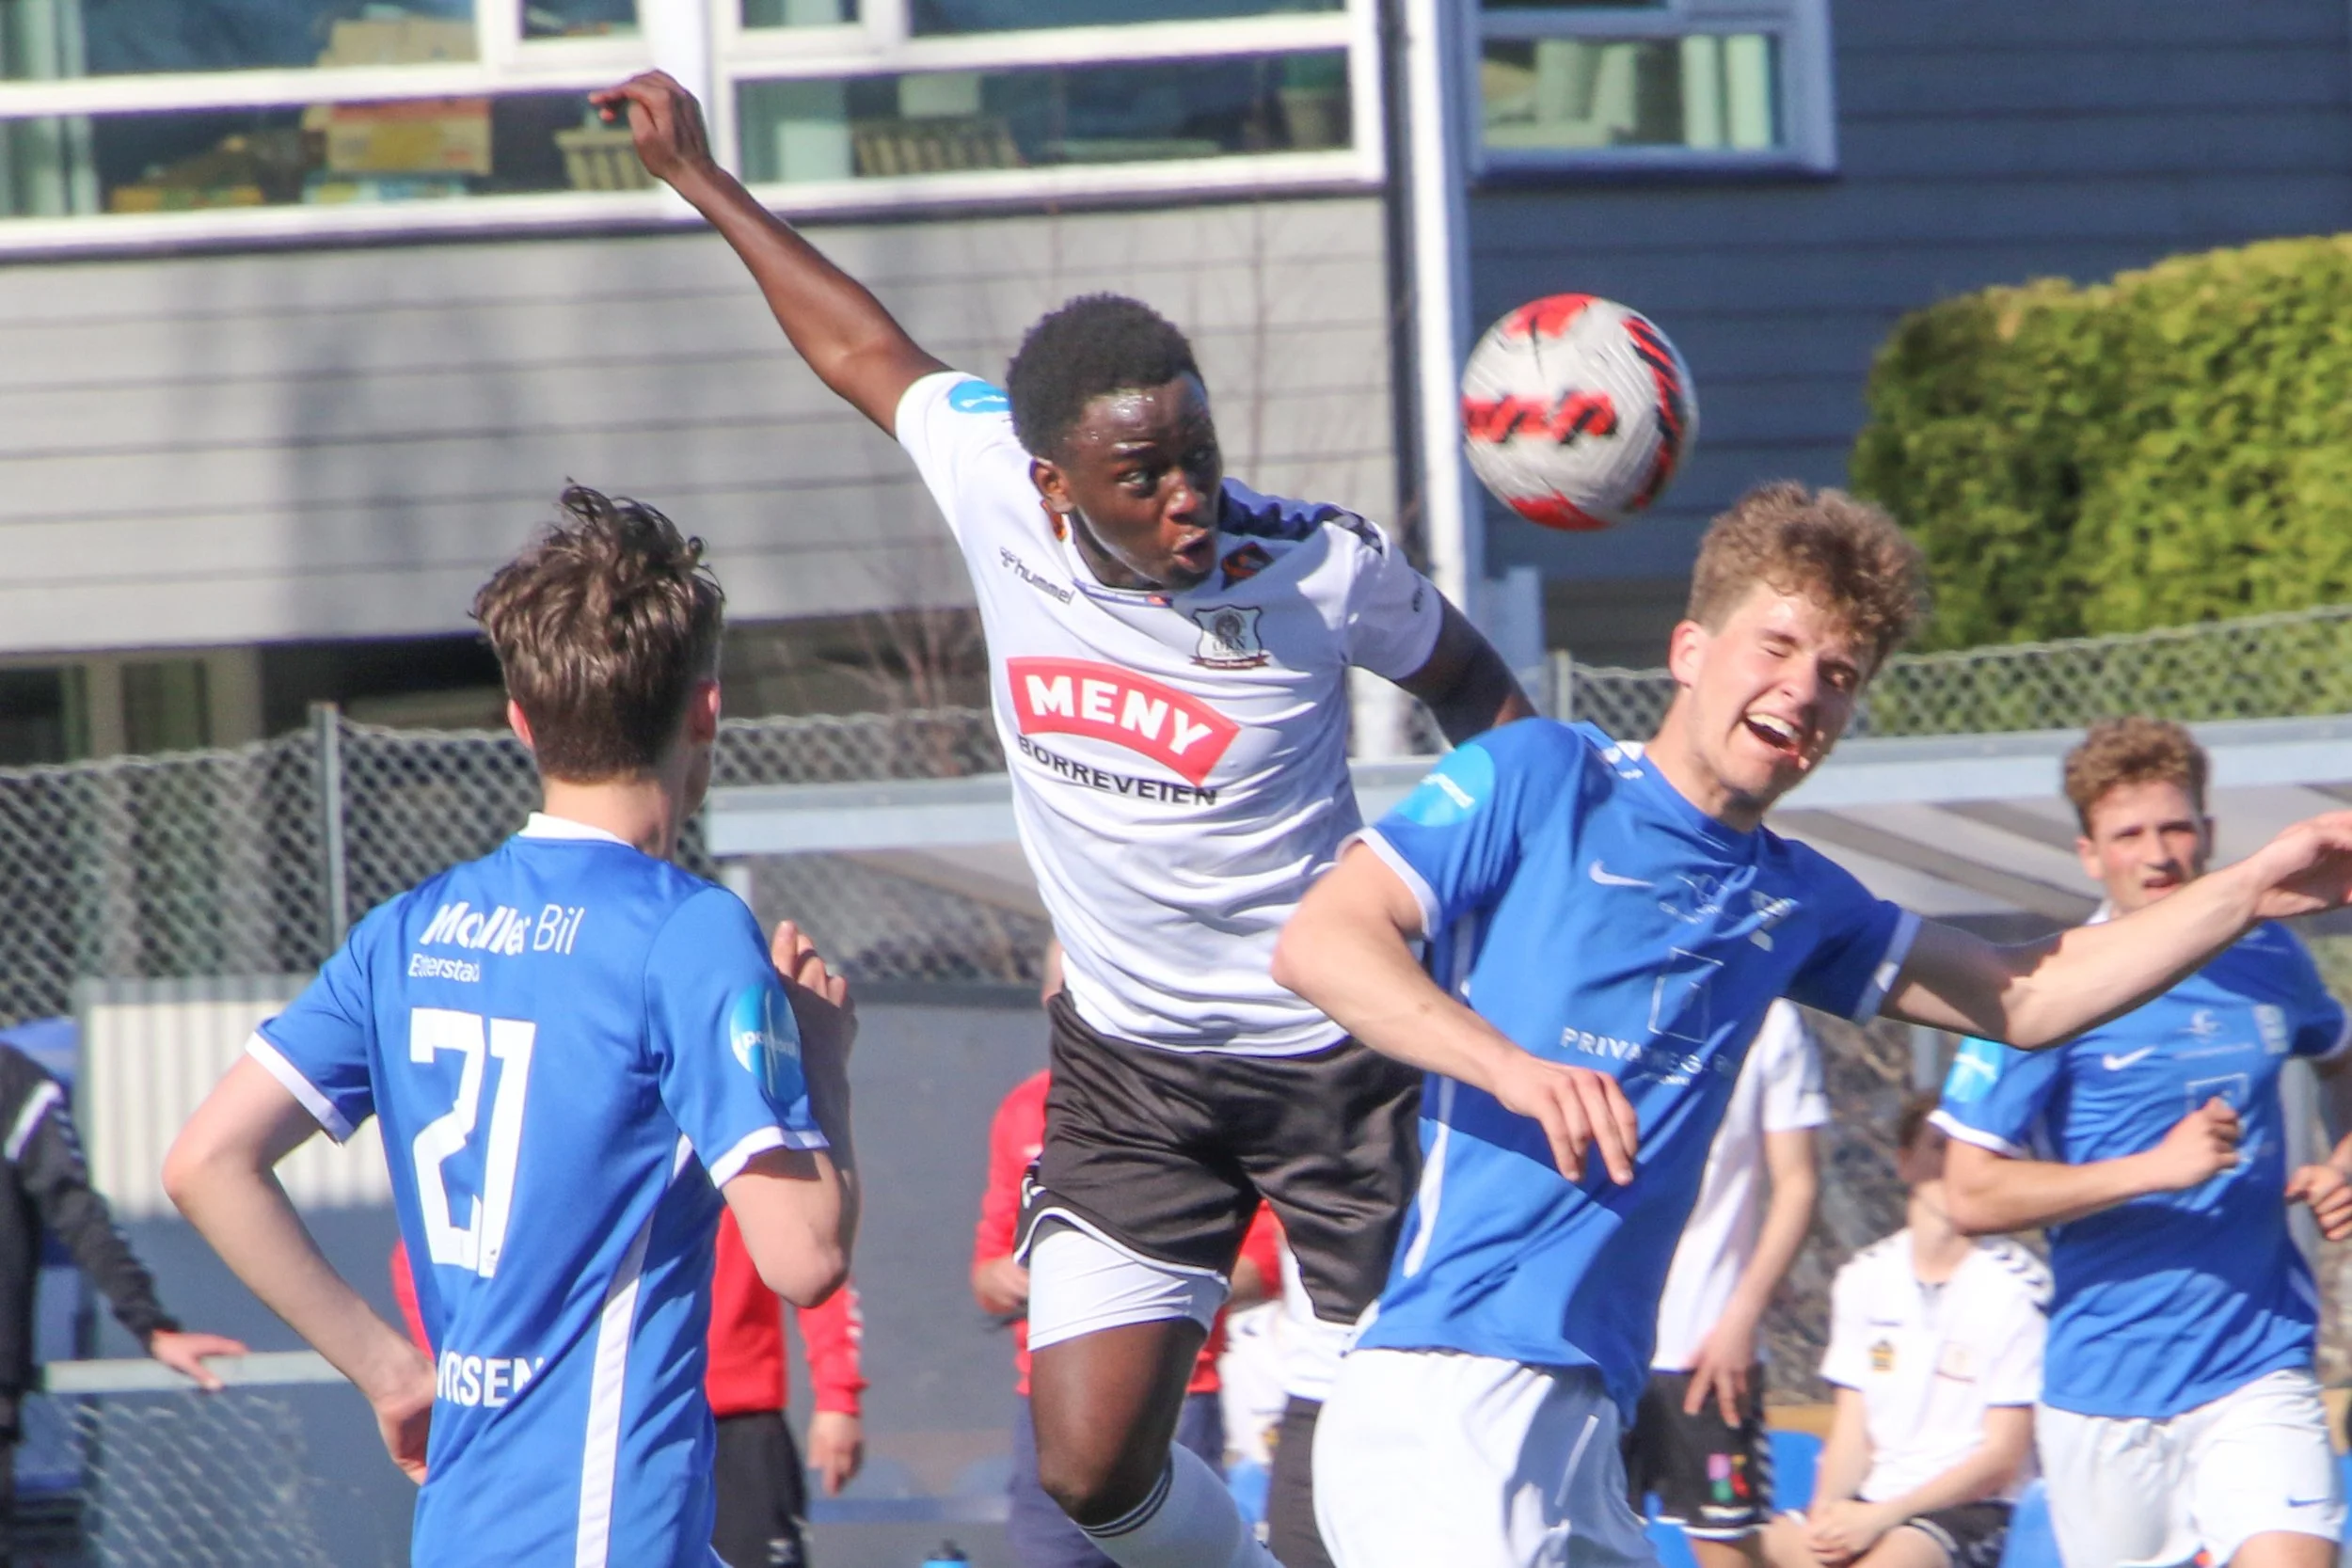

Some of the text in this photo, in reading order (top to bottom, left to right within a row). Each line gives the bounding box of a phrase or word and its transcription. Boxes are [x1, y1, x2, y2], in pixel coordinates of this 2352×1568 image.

[1014, 558, 1076, 606] hummel
[1025, 674, 1214, 756] MENY
[1017, 733, 1217, 806] BORREVEIEN
[532, 902, 586, 956] Bil
[410, 1006, 536, 1279] 21
